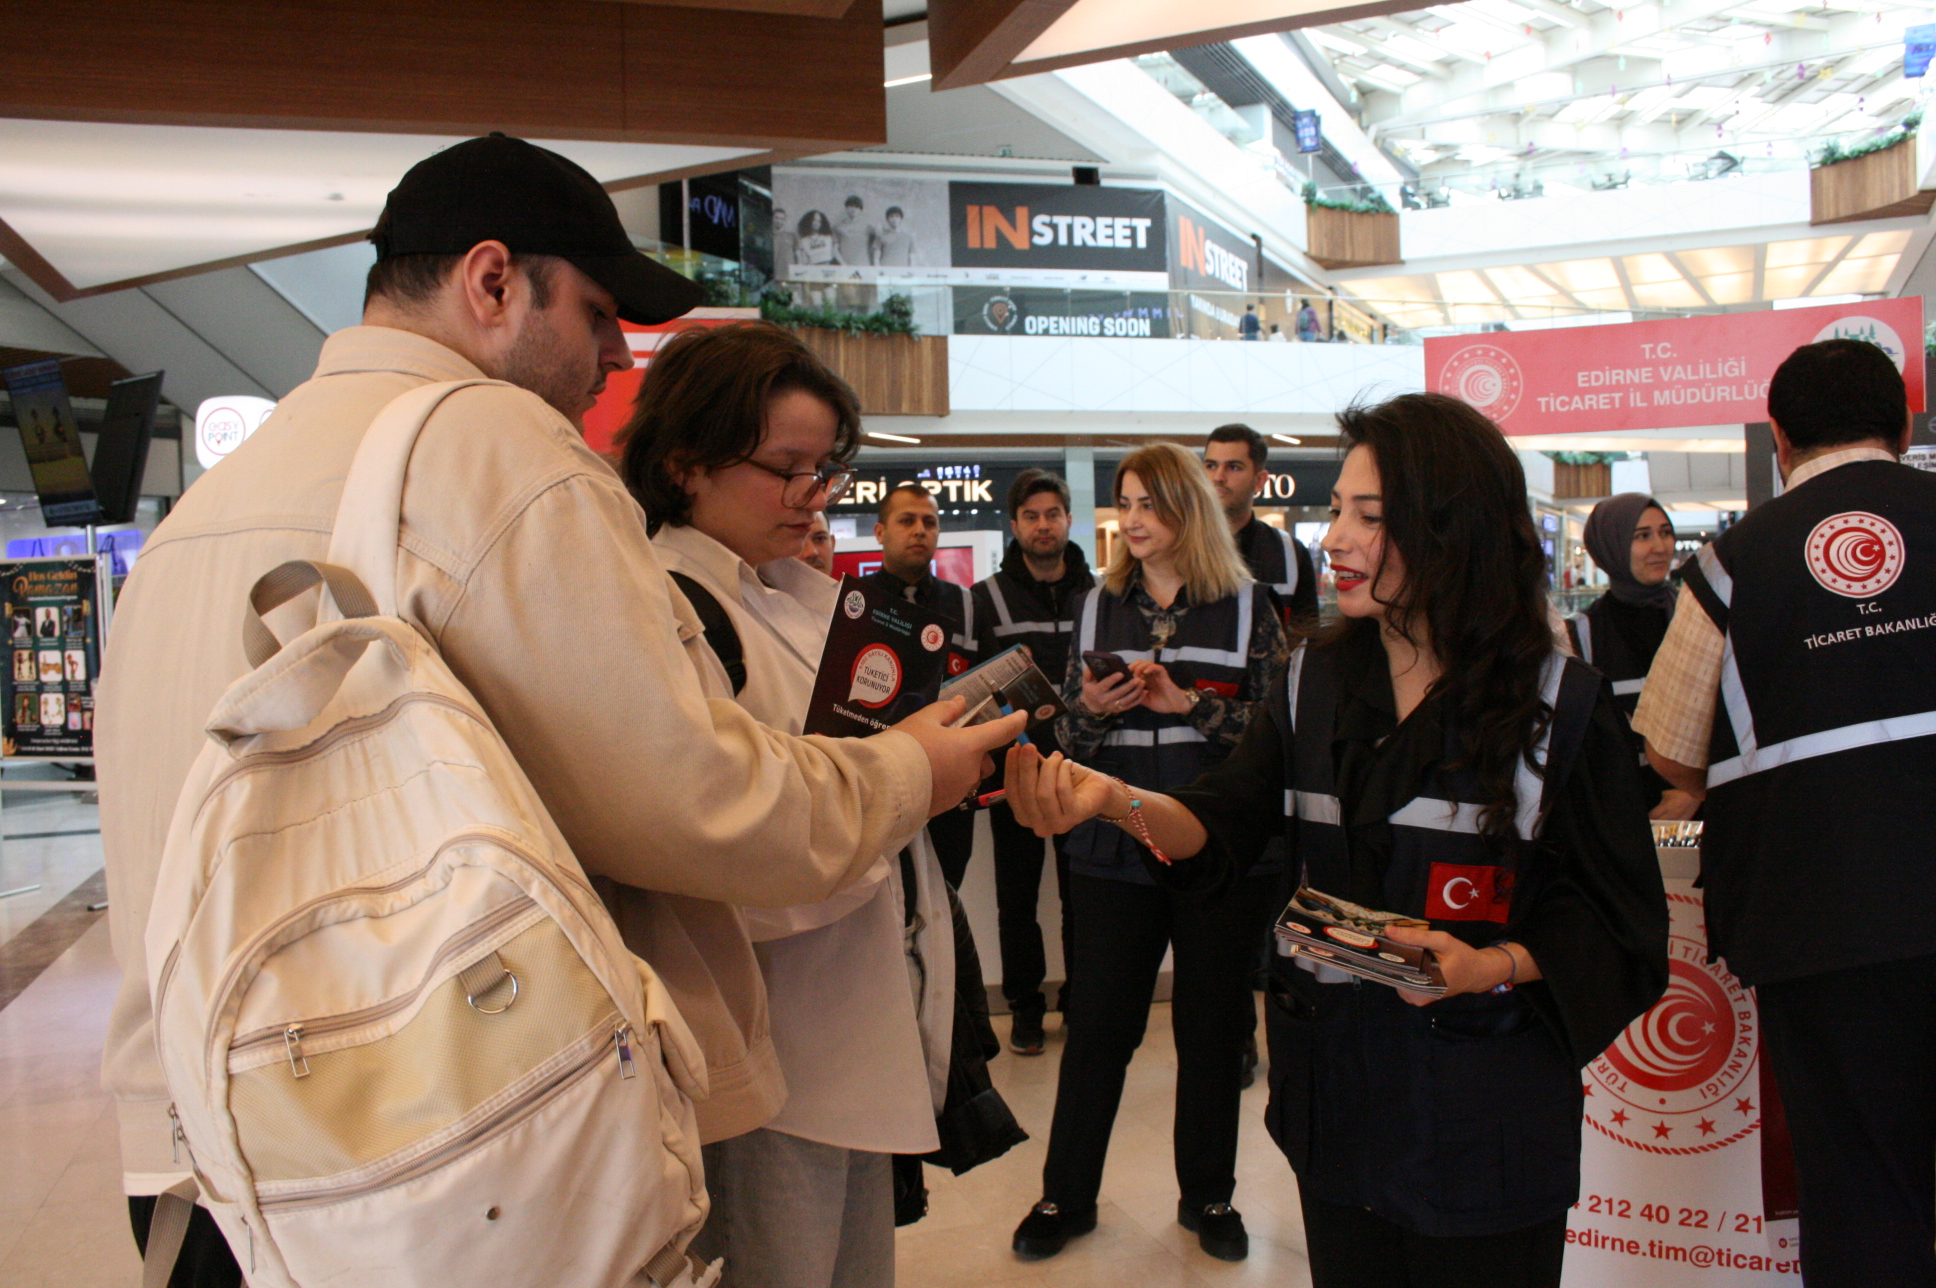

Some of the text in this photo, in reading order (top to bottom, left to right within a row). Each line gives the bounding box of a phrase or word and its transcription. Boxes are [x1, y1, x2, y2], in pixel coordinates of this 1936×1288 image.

[1024, 315, 1152, 337] OPENING SOON
[1640, 342, 1678, 360] T.C.
[1577, 355, 1747, 388] EDİRNE VALİLİĞİ
[1537, 392, 1624, 413] TİCARET
[1629, 387, 1648, 408] İL
[898, 477, 993, 502] PTİK
[1856, 602, 1882, 615] T.C.
[1803, 627, 1862, 650] TİCARET
[856, 675, 891, 695] KORUNUYOR
[864, 665, 889, 683] TÜKETİCİ
[833, 703, 869, 725] Tüketmeden
[1588, 1194, 1763, 1234] 212 40 22 / 21
